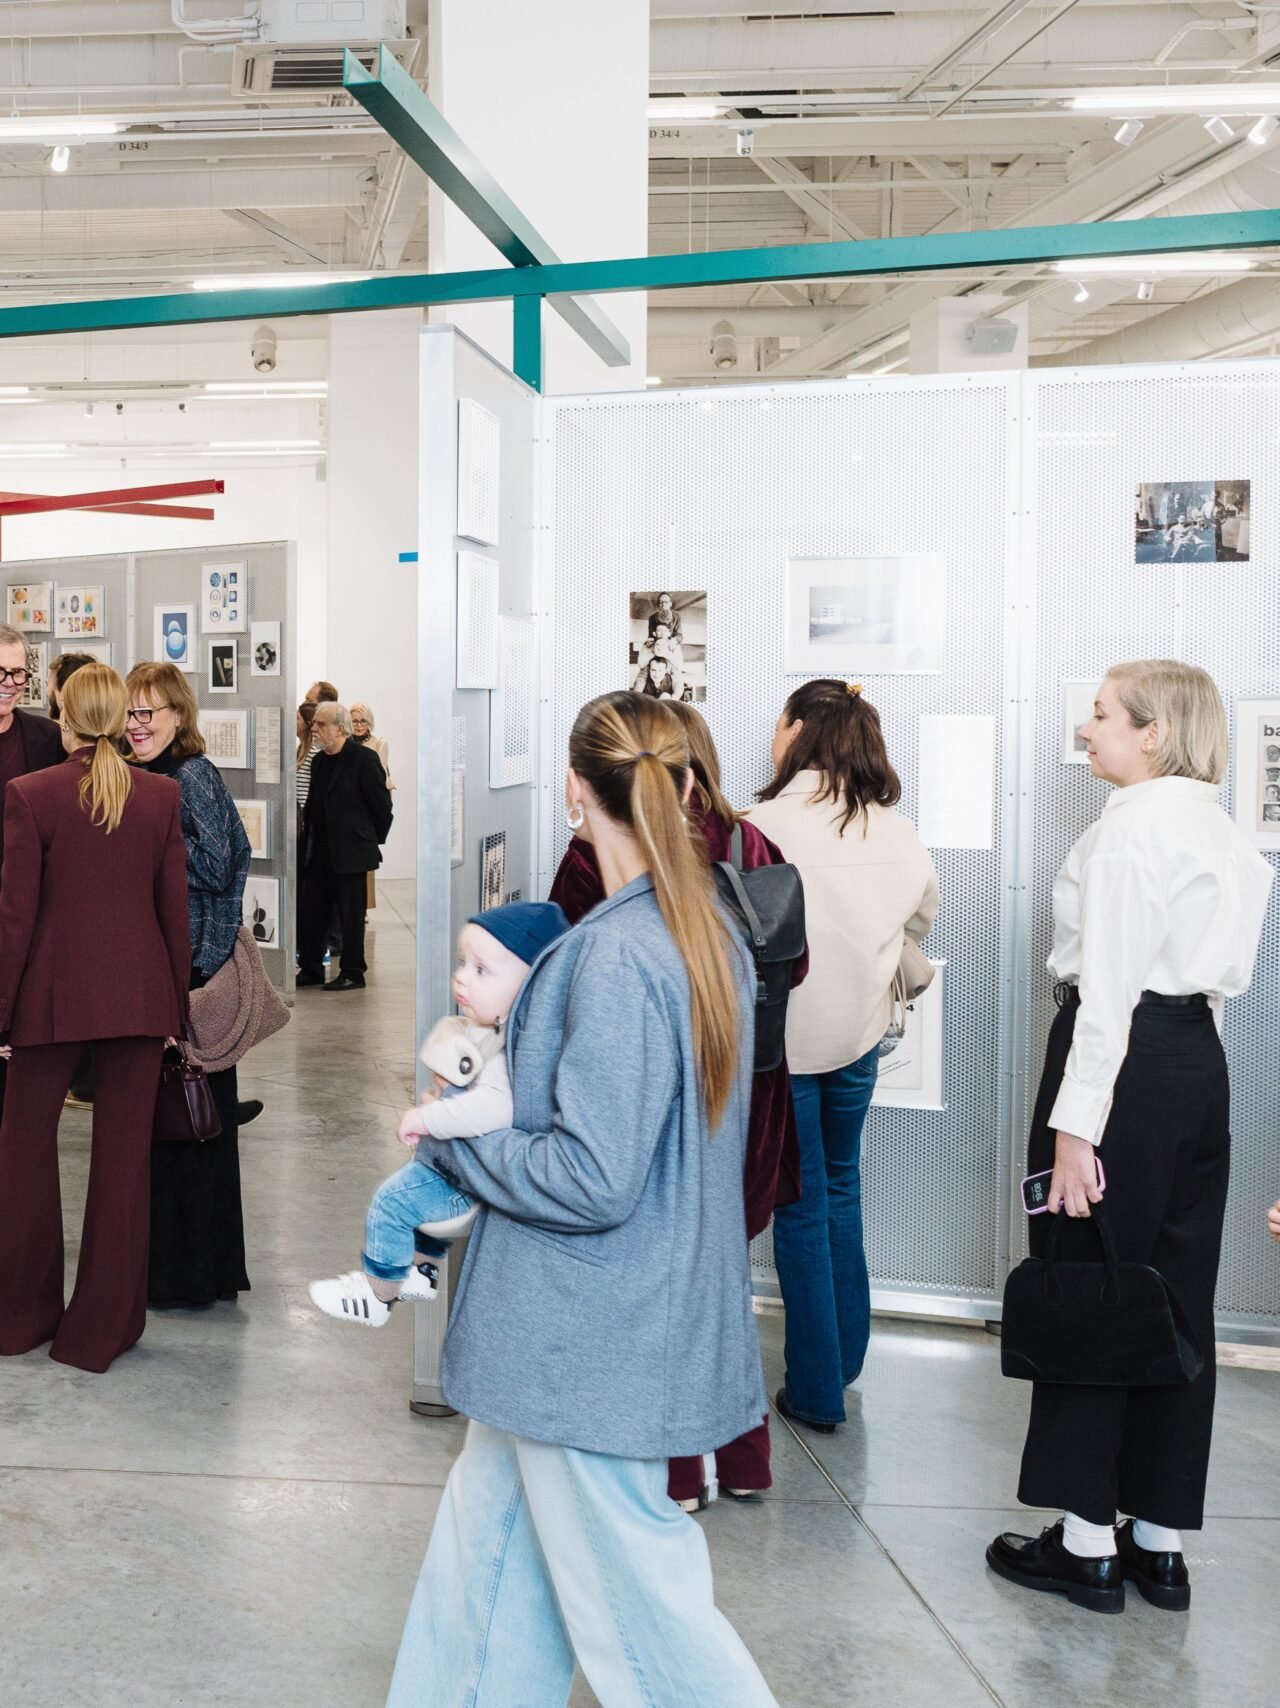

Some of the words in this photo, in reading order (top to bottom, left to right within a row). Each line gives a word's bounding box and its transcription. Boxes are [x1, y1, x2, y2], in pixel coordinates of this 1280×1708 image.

[649, 129, 658, 138] D
[659, 129, 680, 138] 34/4
[119, 142, 127, 151] D
